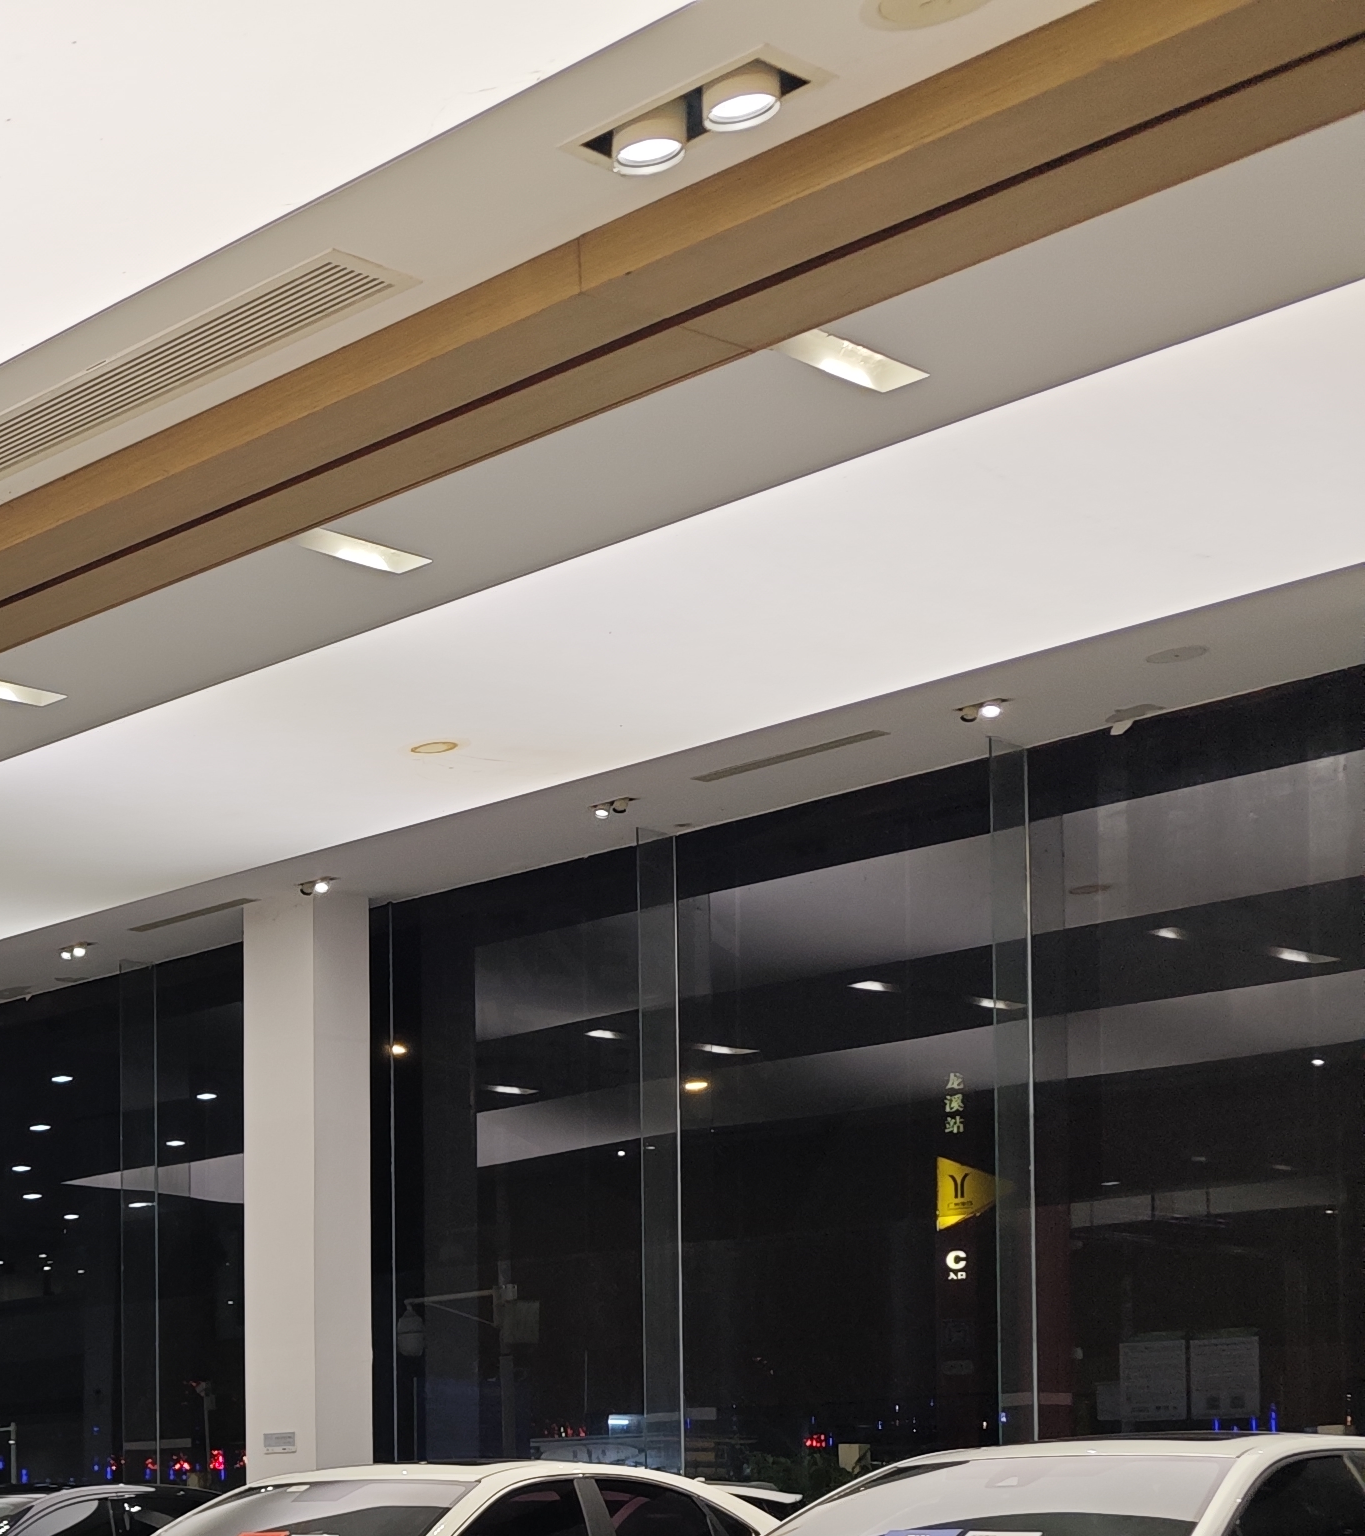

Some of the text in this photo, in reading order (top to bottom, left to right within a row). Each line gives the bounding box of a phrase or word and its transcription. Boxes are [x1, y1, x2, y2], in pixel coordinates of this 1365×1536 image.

[944, 1072, 965, 1134] 龙溪站
[945, 1249, 967, 1270] C
